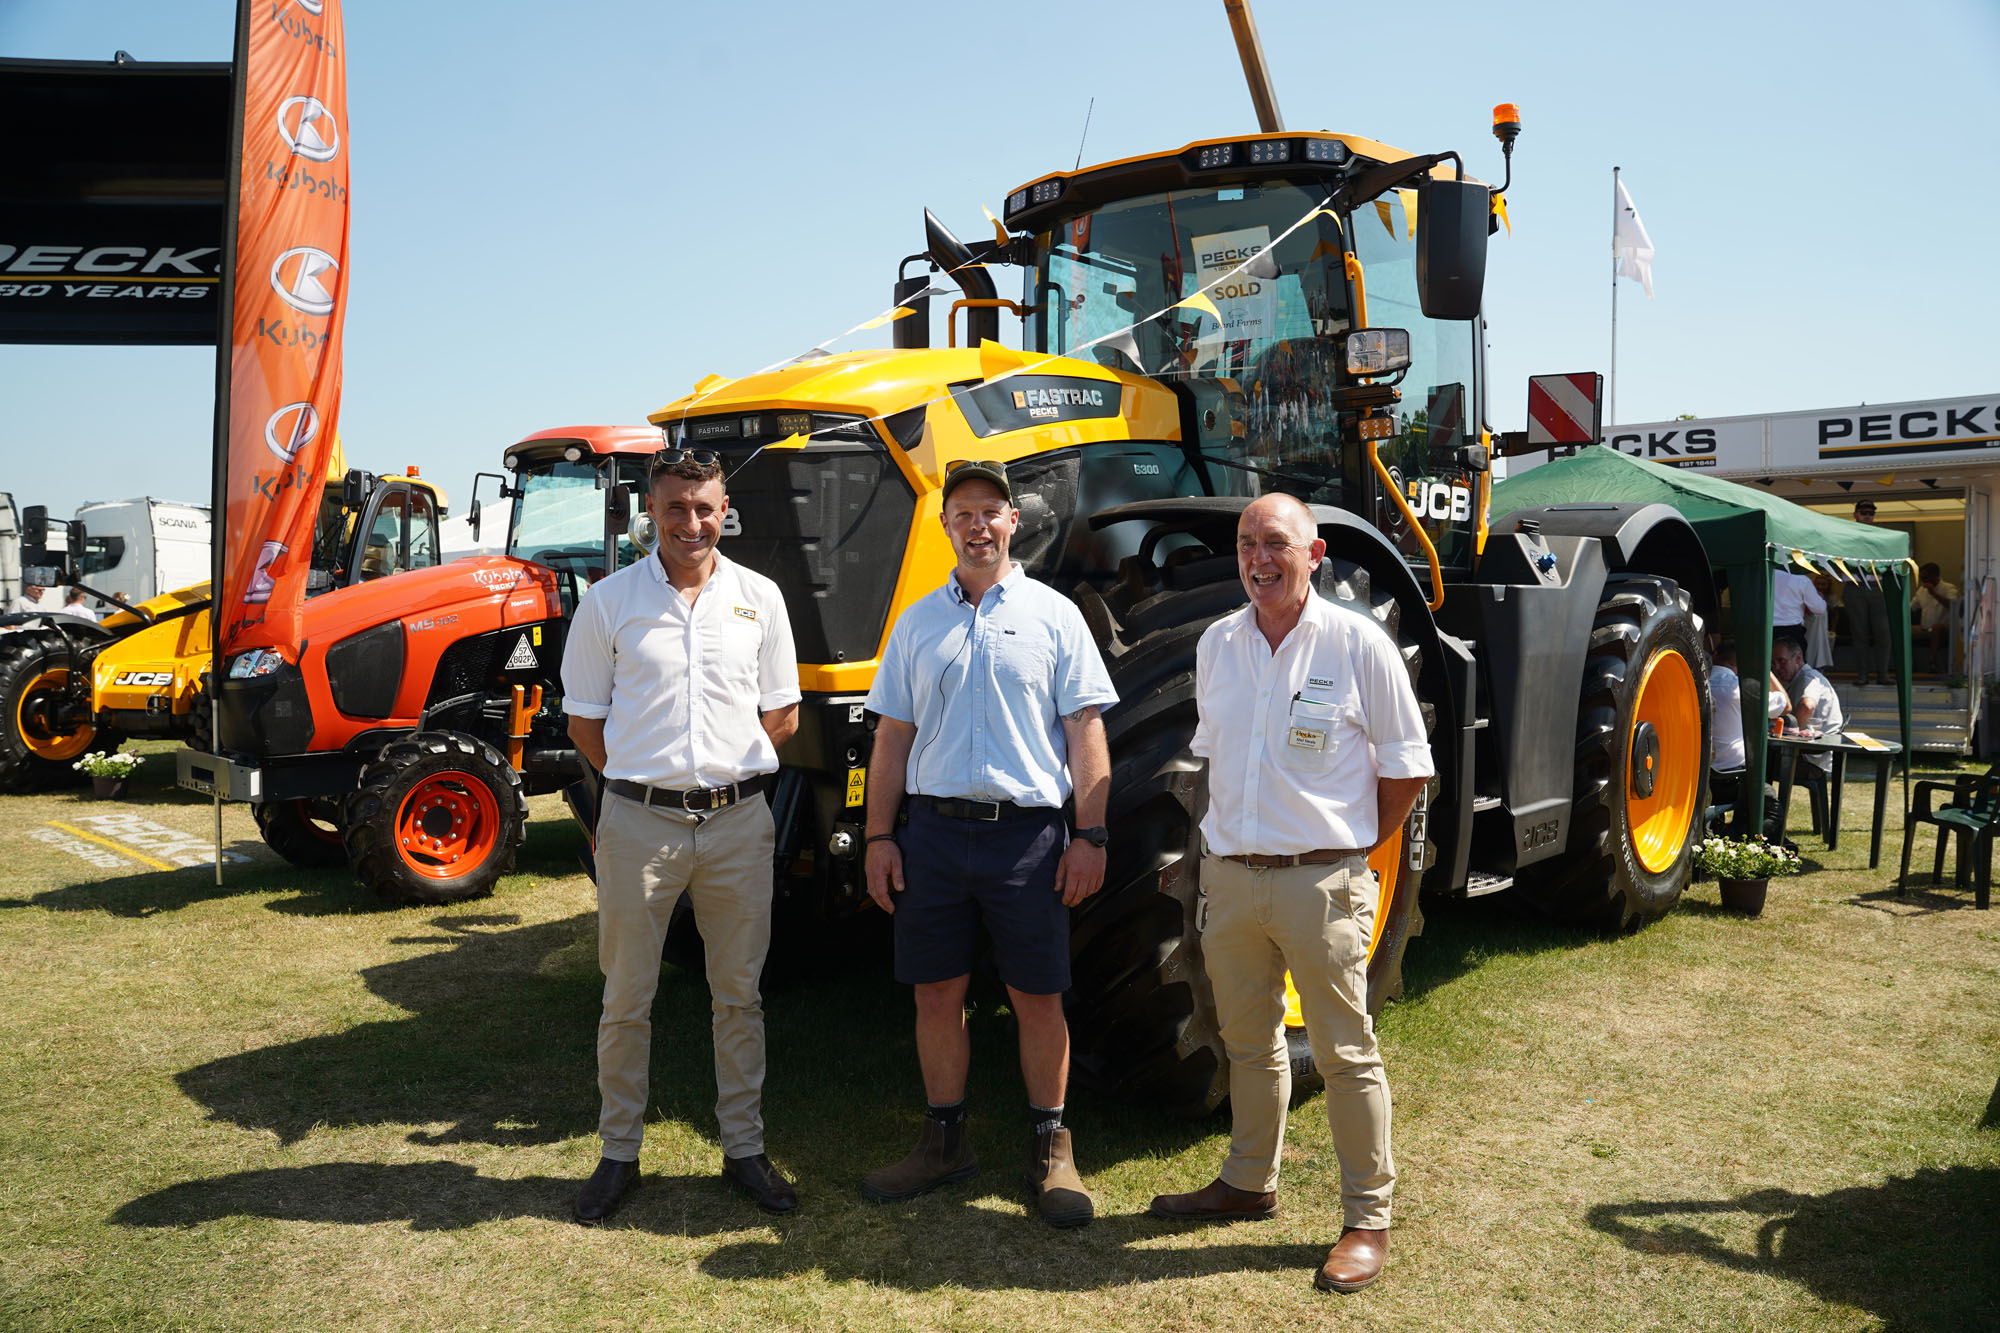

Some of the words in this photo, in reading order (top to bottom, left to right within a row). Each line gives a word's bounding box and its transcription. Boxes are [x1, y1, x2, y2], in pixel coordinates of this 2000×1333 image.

[0, 244, 220, 273] ECK
[1202, 246, 1262, 264] PECKS
[64, 285, 209, 298] YEARS
[1214, 282, 1262, 300] SOLD
[1025, 388, 1103, 407] FASTRAC
[1029, 407, 1058, 416] PECKS
[698, 425, 730, 435] FASTRAC
[1819, 406, 2000, 445] PECK
[1548, 428, 1717, 463] CKS
[1133, 464, 1160, 475] 6300
[1407, 481, 1471, 522] JCB
[158, 517, 198, 529] SCANIA
[472, 568, 523, 585] Kubota
[735, 608, 755, 619] JCB
[115, 673, 173, 686] JCB
[1523, 819, 1559, 853] JCB
